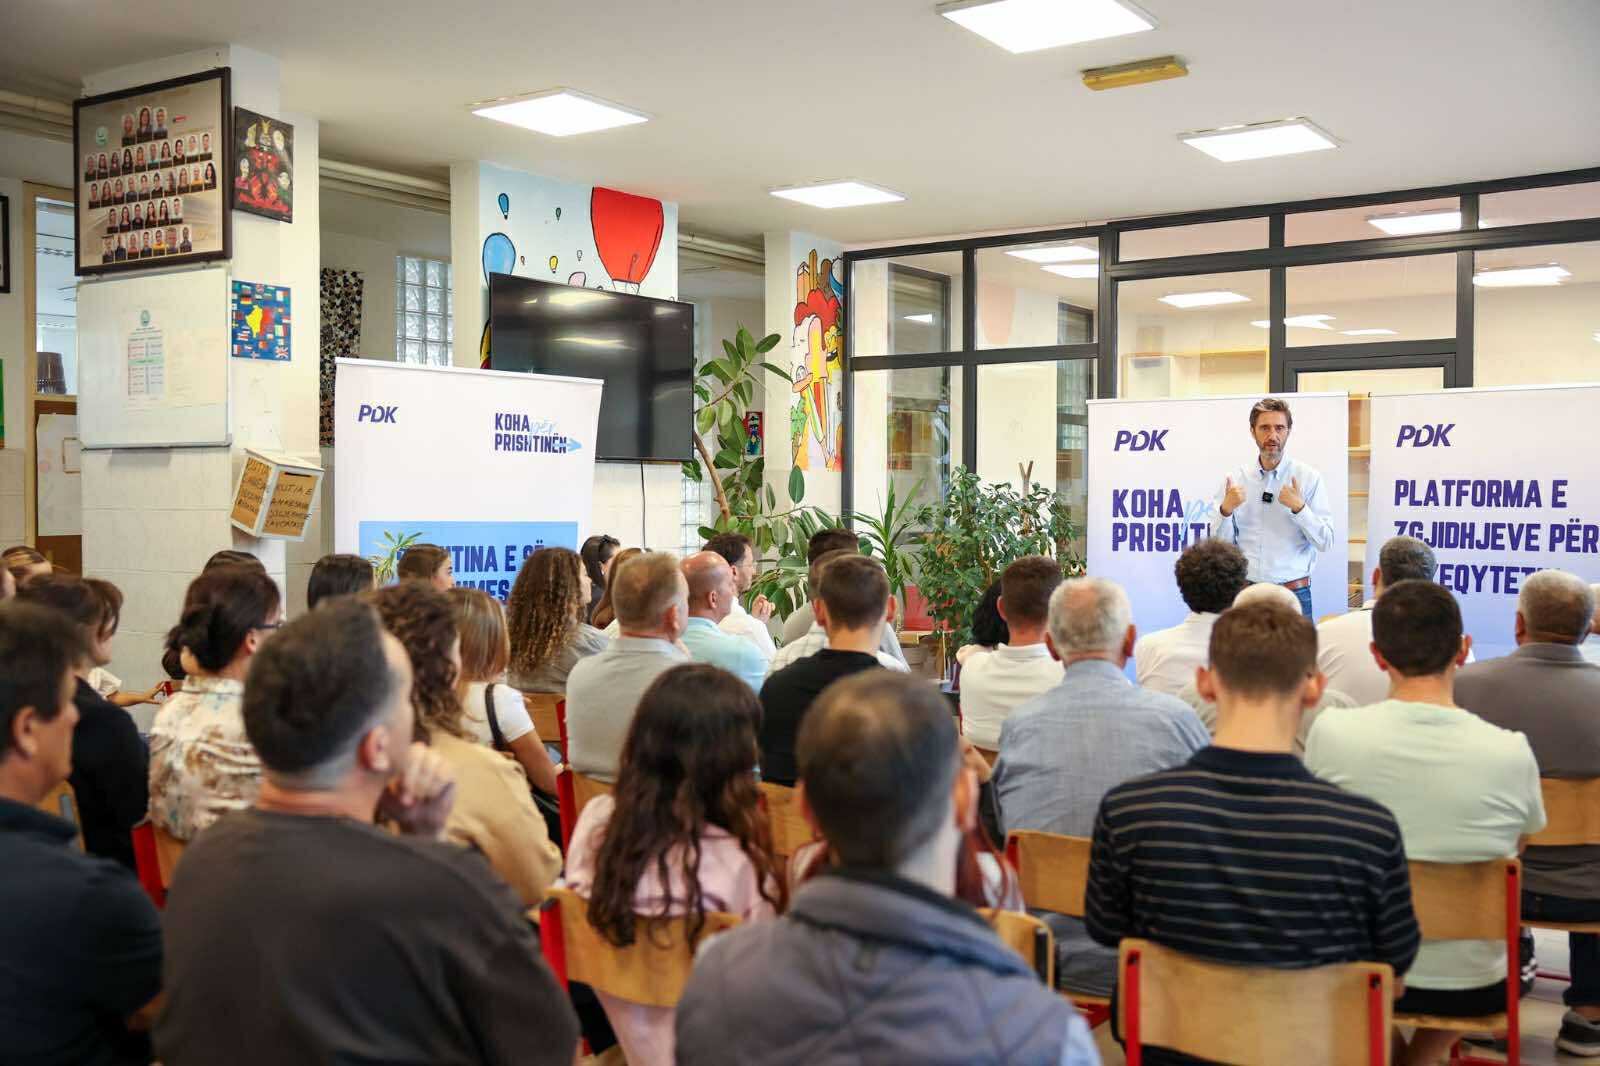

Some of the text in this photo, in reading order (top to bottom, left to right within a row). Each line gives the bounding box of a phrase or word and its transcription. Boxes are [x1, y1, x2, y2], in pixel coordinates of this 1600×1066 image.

[358, 404, 398, 424] PDK
[495, 412, 530, 432] KOHA
[495, 432, 567, 454] PRISHTINËN
[1114, 429, 1170, 452] PDK
[1396, 423, 1456, 448] PDK
[1112, 488, 1184, 518] KOHA
[1394, 479, 1568, 509] PLATFORMA E
[1394, 518, 1600, 553] ZGJIDHJEVE PËR
[504, 545, 517, 572] E
